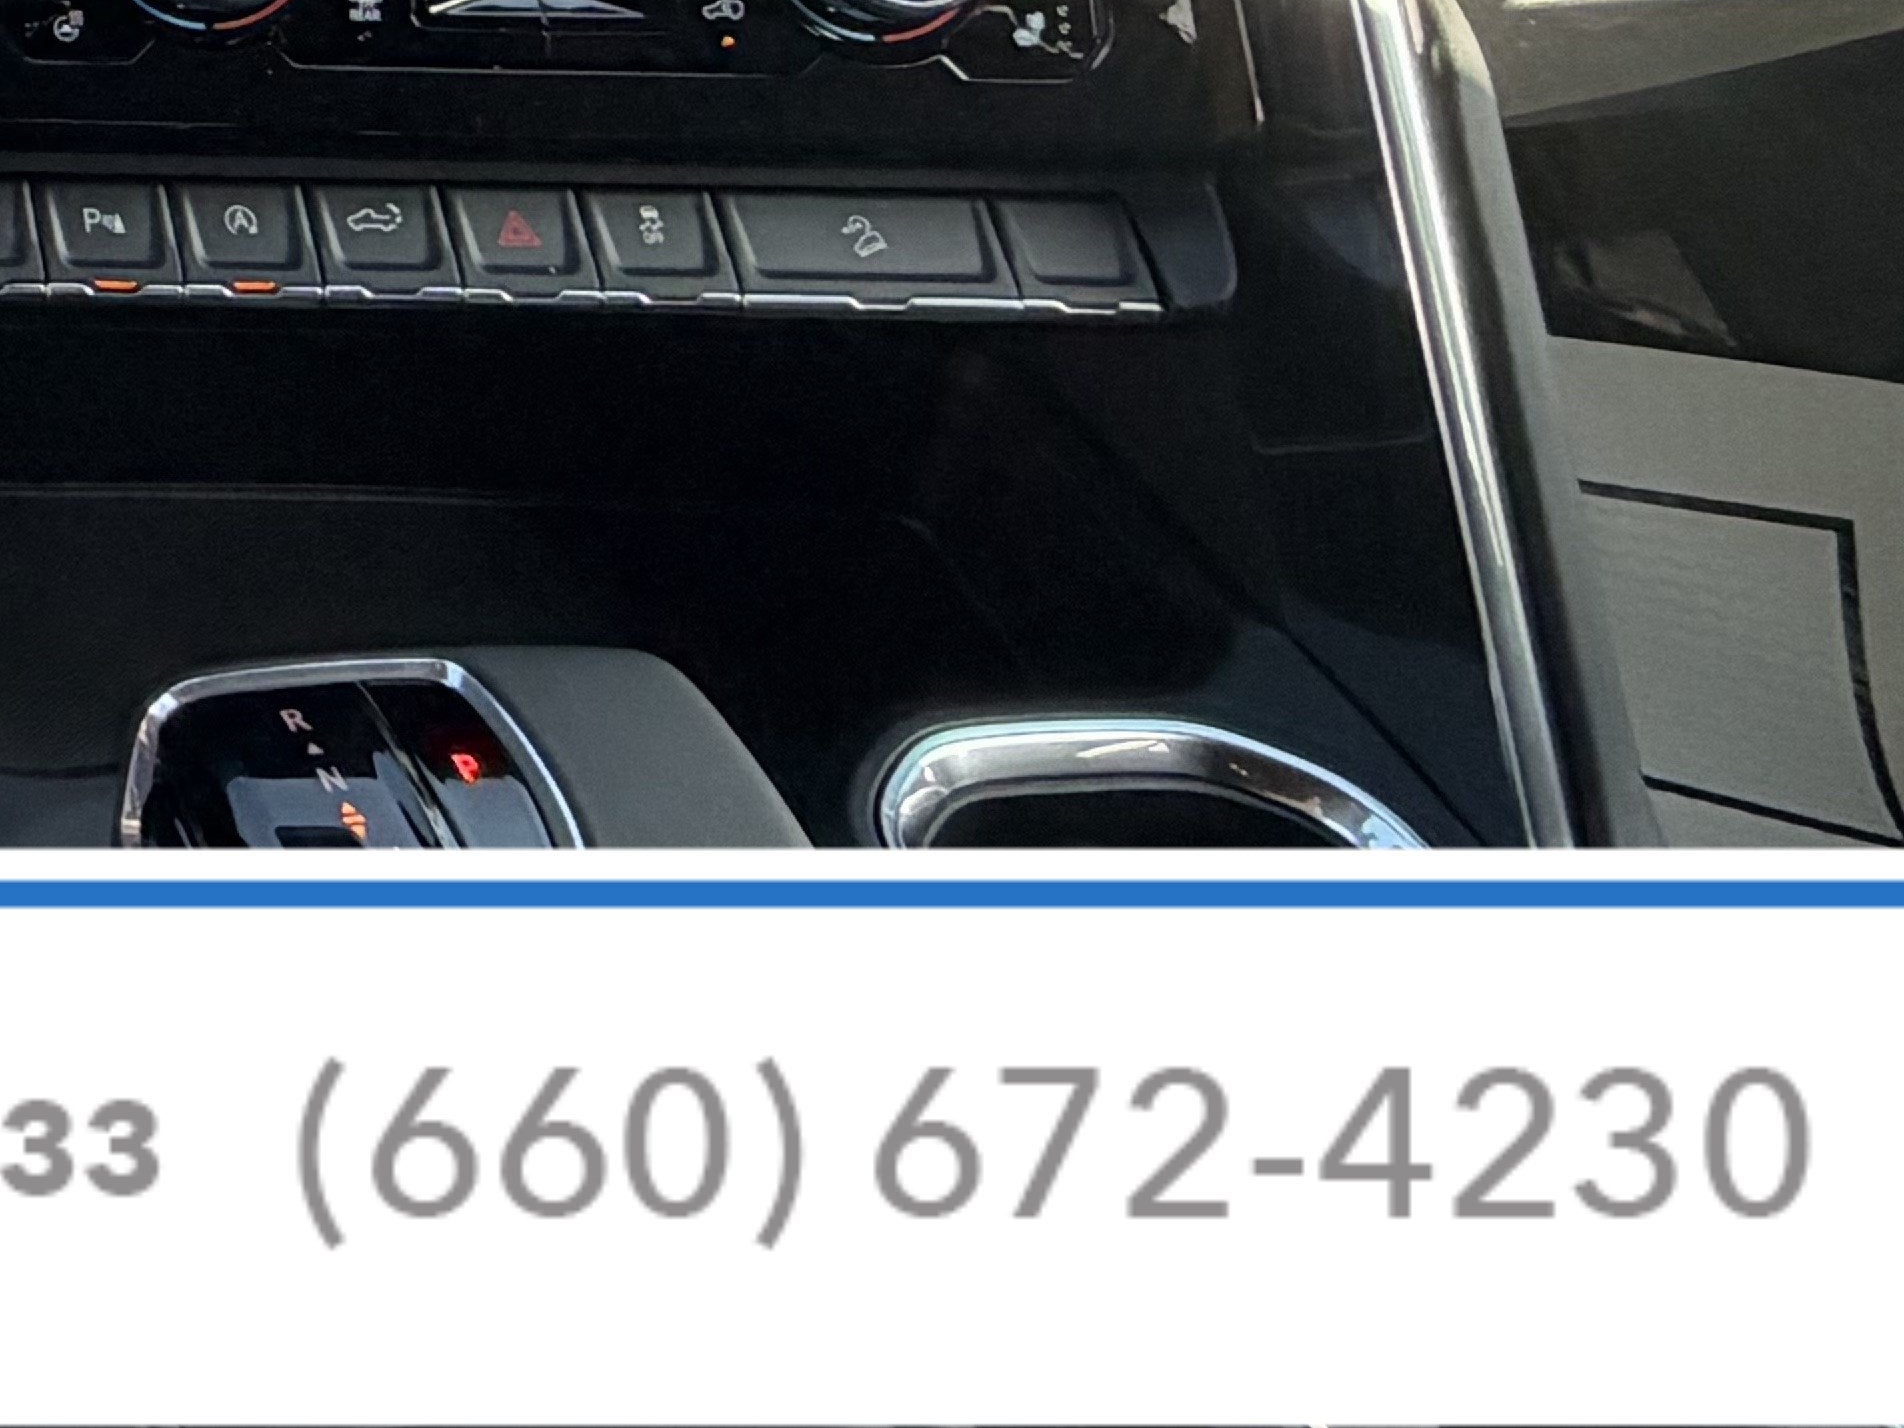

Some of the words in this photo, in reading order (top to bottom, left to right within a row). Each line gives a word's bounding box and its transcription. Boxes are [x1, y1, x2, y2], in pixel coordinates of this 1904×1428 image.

[279, 708, 313, 734] R
[315, 766, 349, 793] N
[451, 753, 483, 785] P
